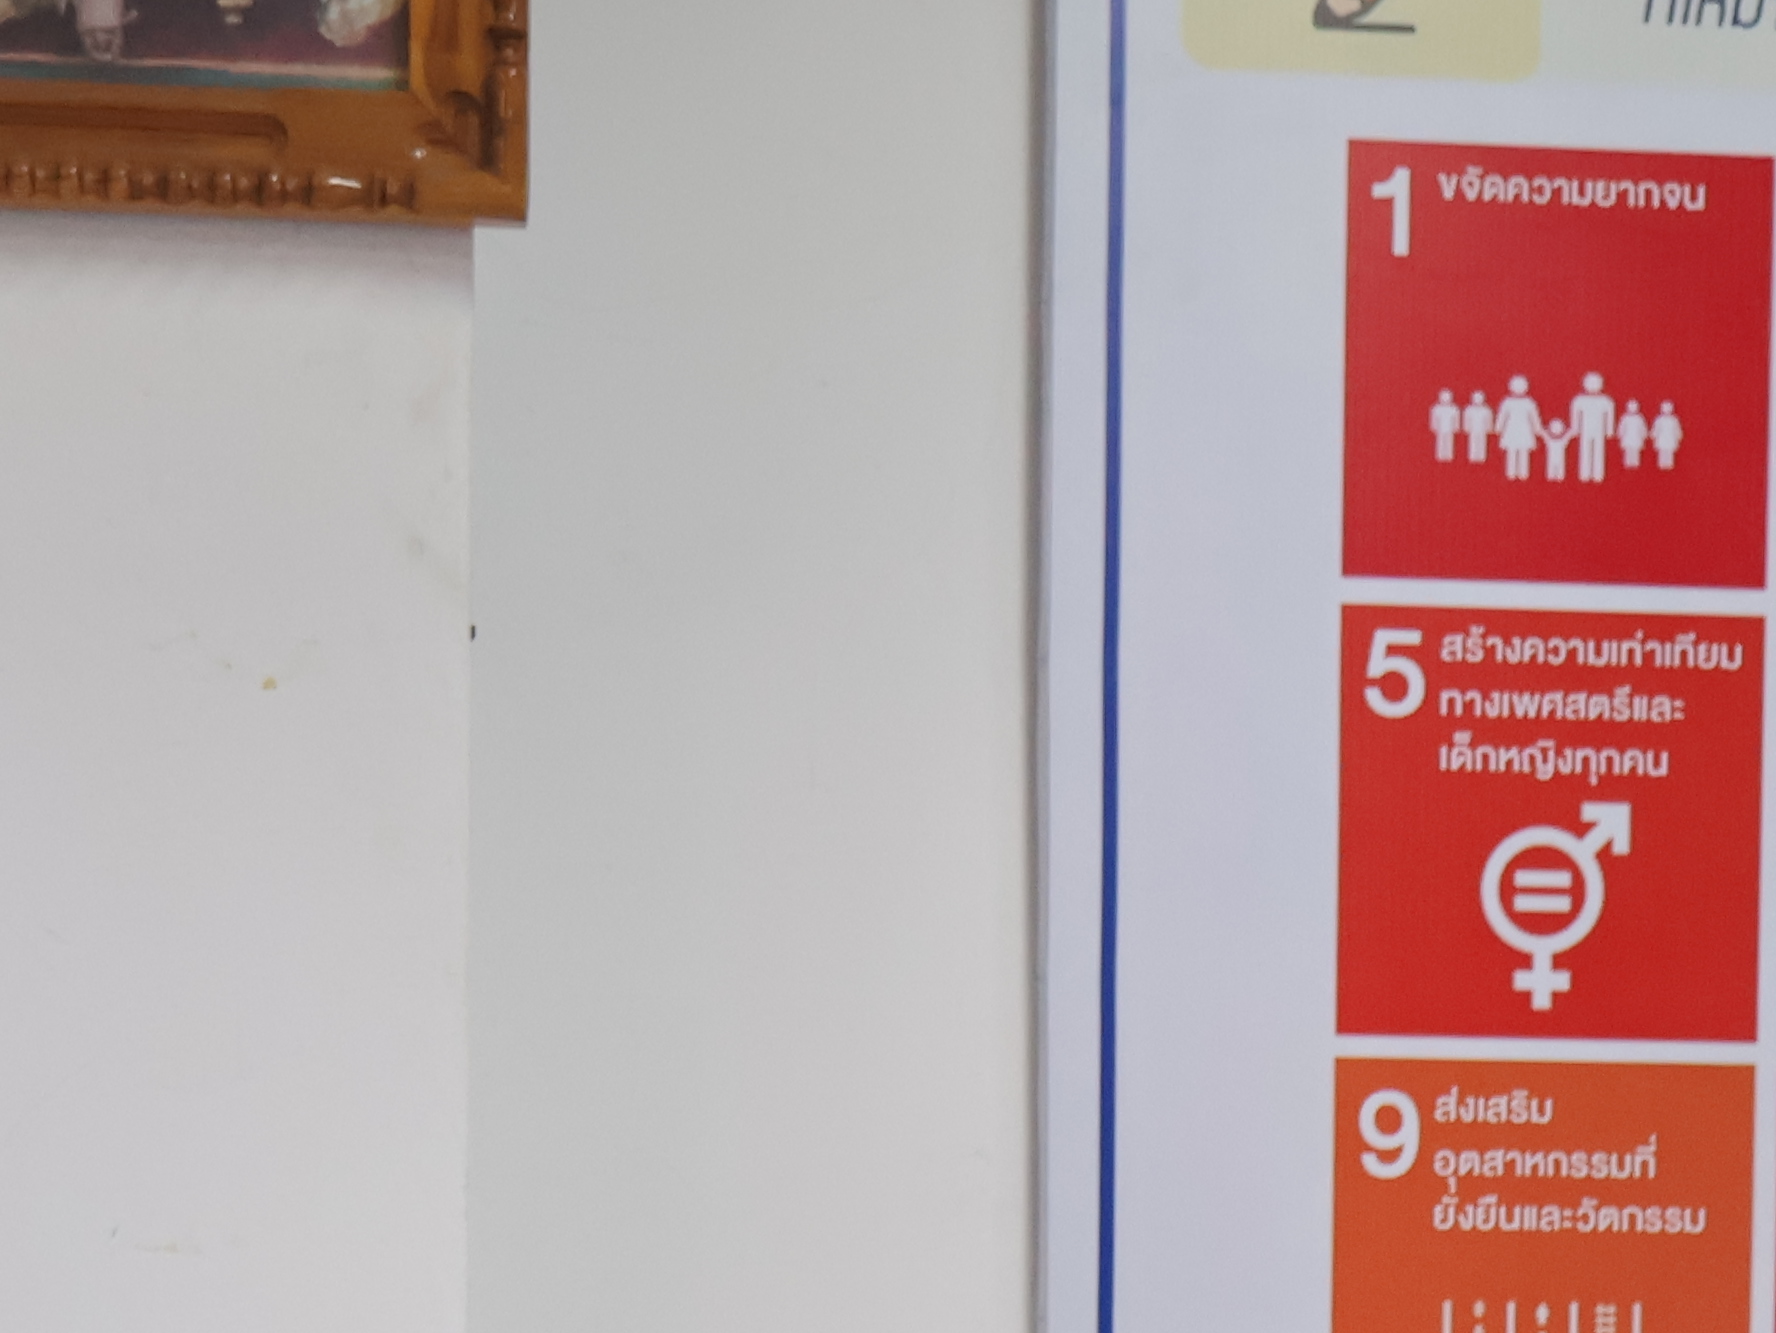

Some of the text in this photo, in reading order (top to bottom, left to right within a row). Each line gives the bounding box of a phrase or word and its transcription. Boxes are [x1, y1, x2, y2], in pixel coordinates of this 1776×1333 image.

[1370, 164, 1413, 258] 1
[1436, 167, 1707, 215] ขจัดความยากจน
[1362, 628, 1426, 718] 5
[1440, 625, 1745, 672] สร้างความเท่าเทียม
[1438, 681, 1686, 726] ทางเพศสตรีและ
[1438, 730, 1670, 785] เด็กหญิงทุกคน
[1357, 1088, 1420, 1180] 9
[1433, 1087, 1553, 1127] ส่งเสริม
[1433, 1135, 1658, 1194] อุตสาหกรรมที่
